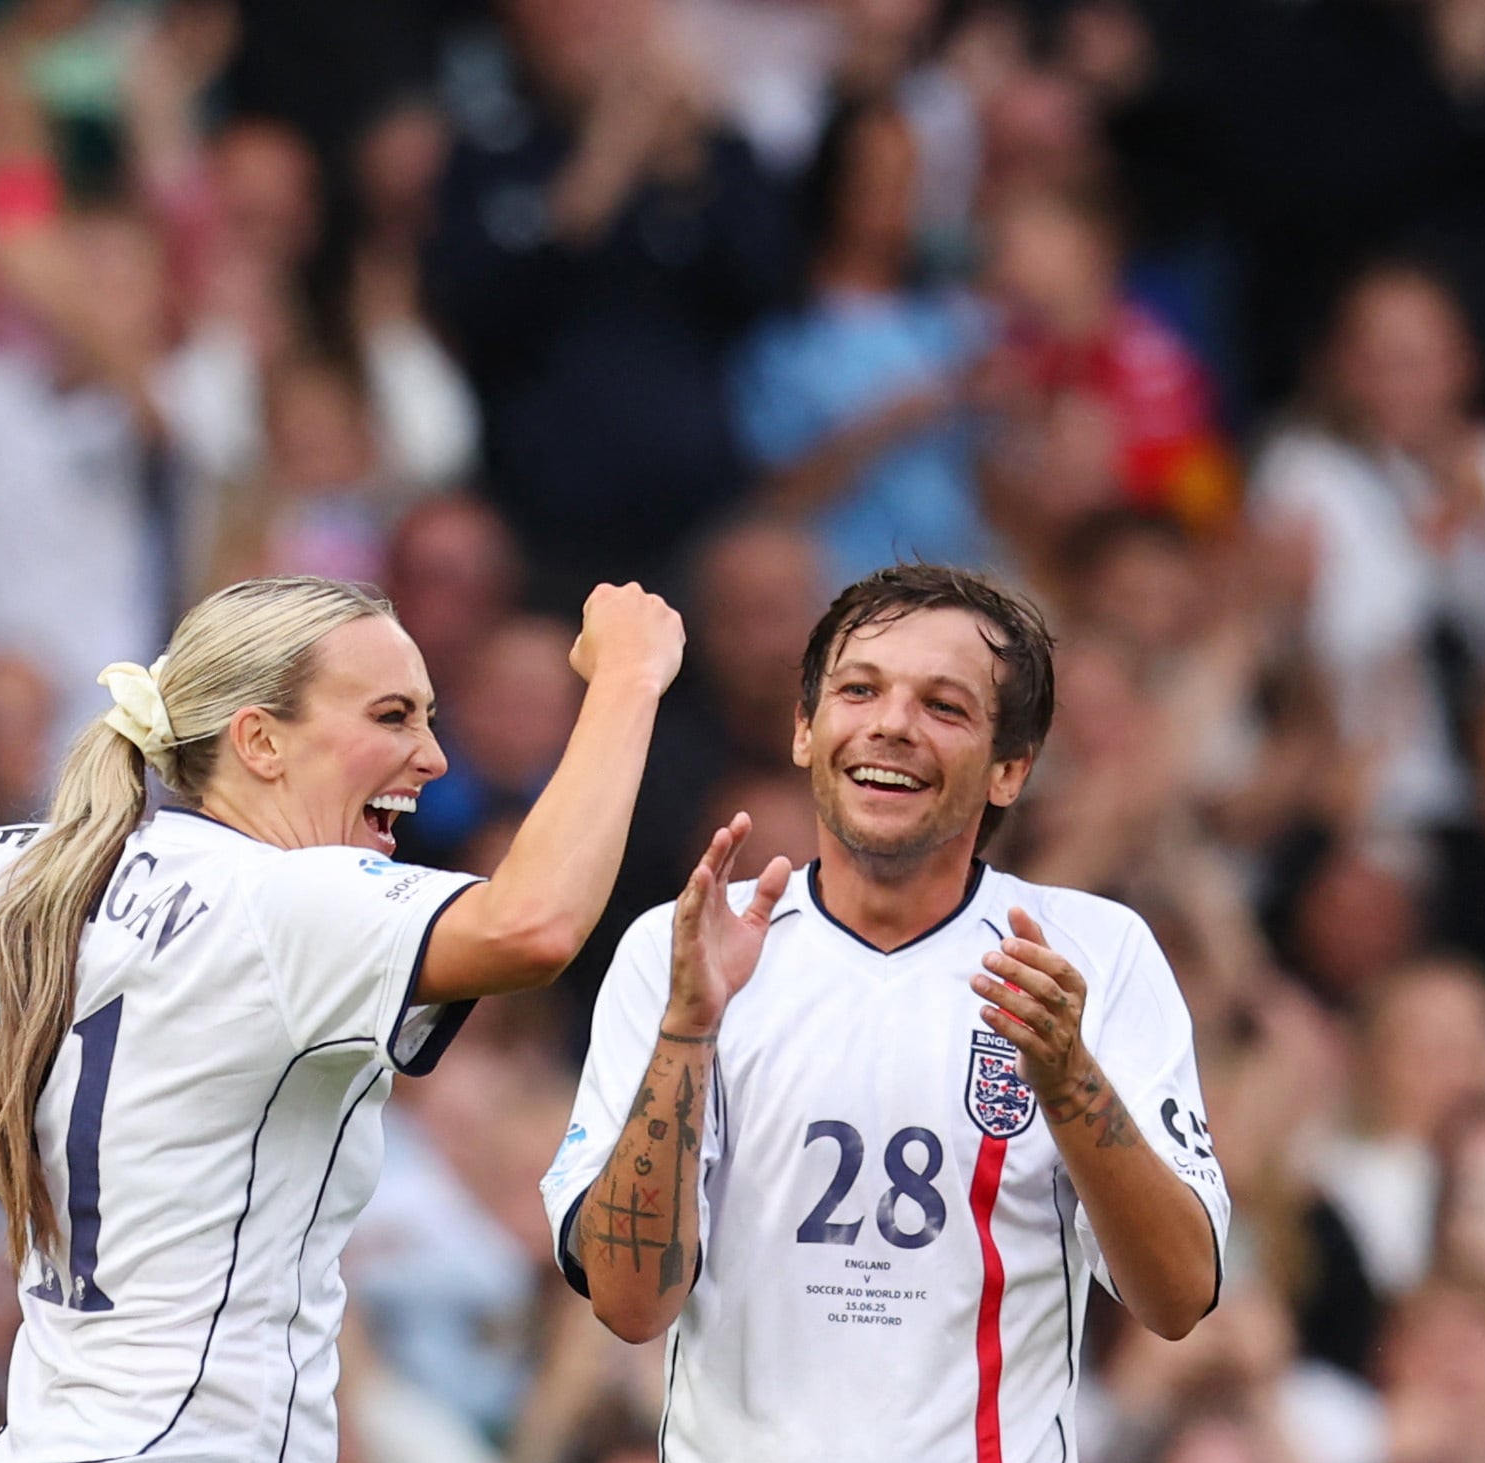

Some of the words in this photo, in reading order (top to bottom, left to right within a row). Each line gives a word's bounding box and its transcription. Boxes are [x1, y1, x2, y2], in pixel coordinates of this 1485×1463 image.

[976, 1033, 1017, 1050] ENGL
[796, 1119, 947, 1249] 28
[844, 1259, 891, 1271] ENGLAND
[863, 1274, 871, 1284] V
[805, 1285, 844, 1296] SOCCER
[845, 1287, 863, 1297] AID
[865, 1289, 901, 1299] WORLD
[903, 1290, 913, 1300] XI
[915, 1290, 927, 1300] FC
[845, 1302, 886, 1312] 15.06.25
[827, 1313, 848, 1323] OLD
[851, 1315, 902, 1326] TRAFFORD
